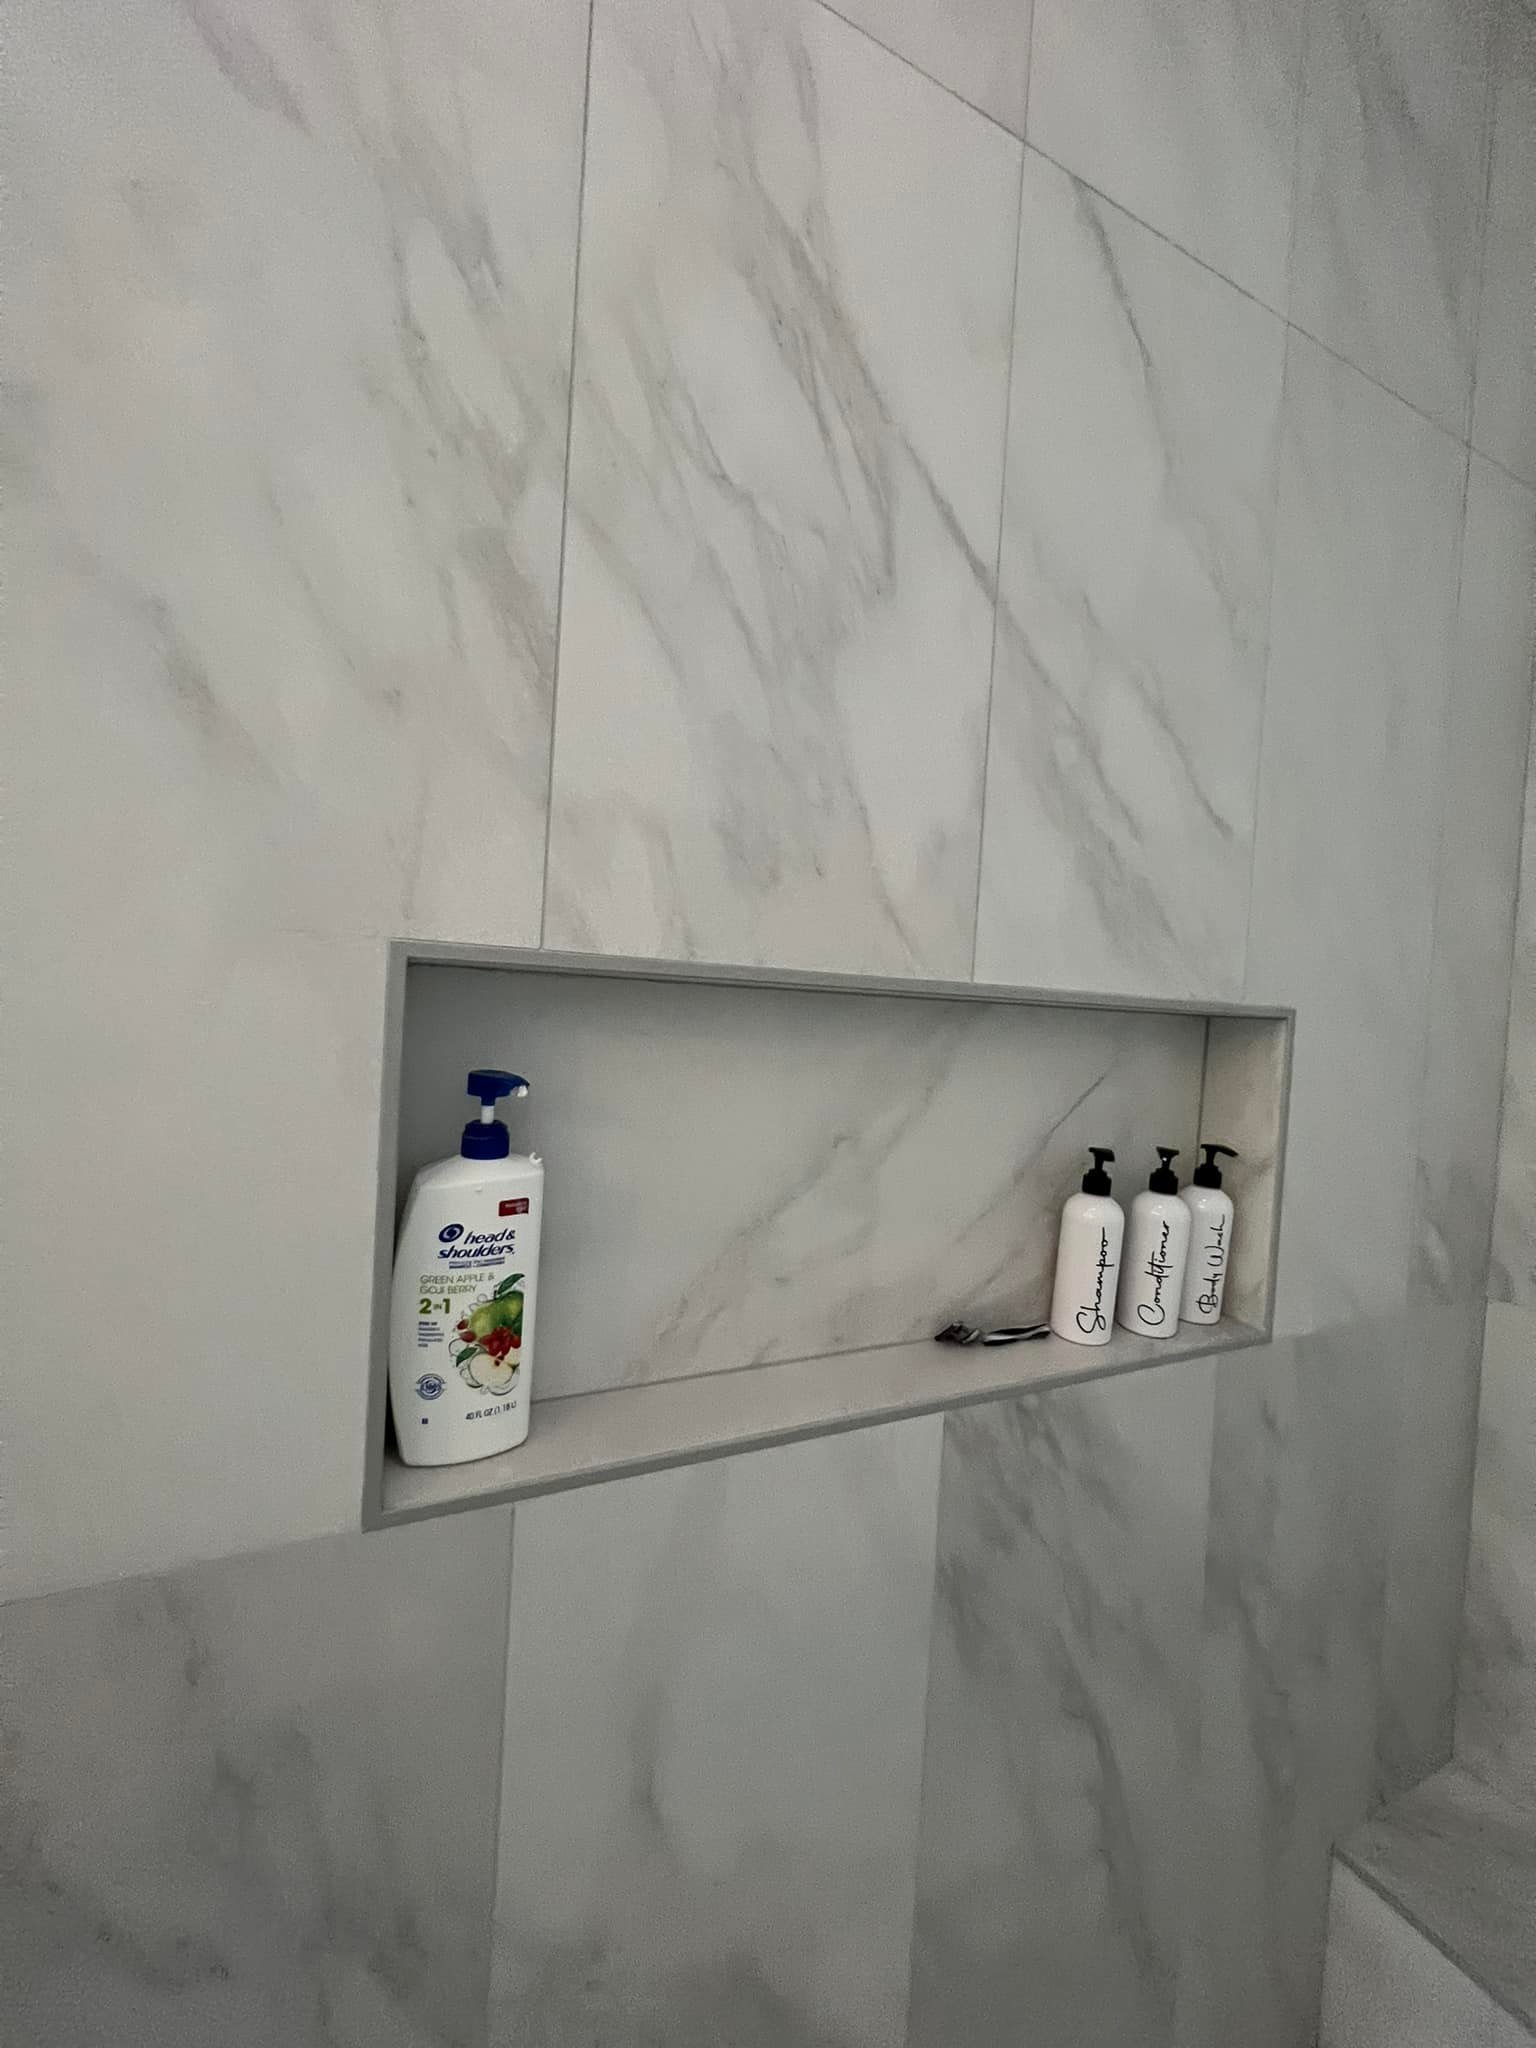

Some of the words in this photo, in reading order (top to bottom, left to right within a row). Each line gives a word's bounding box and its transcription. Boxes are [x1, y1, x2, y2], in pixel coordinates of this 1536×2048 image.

[1204, 1214, 1226, 1267] Wash
[420, 1274, 455, 1285] GREEN
[456, 1272, 484, 1282] APPLE
[488, 1272, 495, 1280] &
[447, 1284, 477, 1295] BERRY
[1076, 1226, 1115, 1334] Shampoo
[1137, 1220, 1174, 1326] Conditioner
[1195, 1272, 1224, 1314] Body
